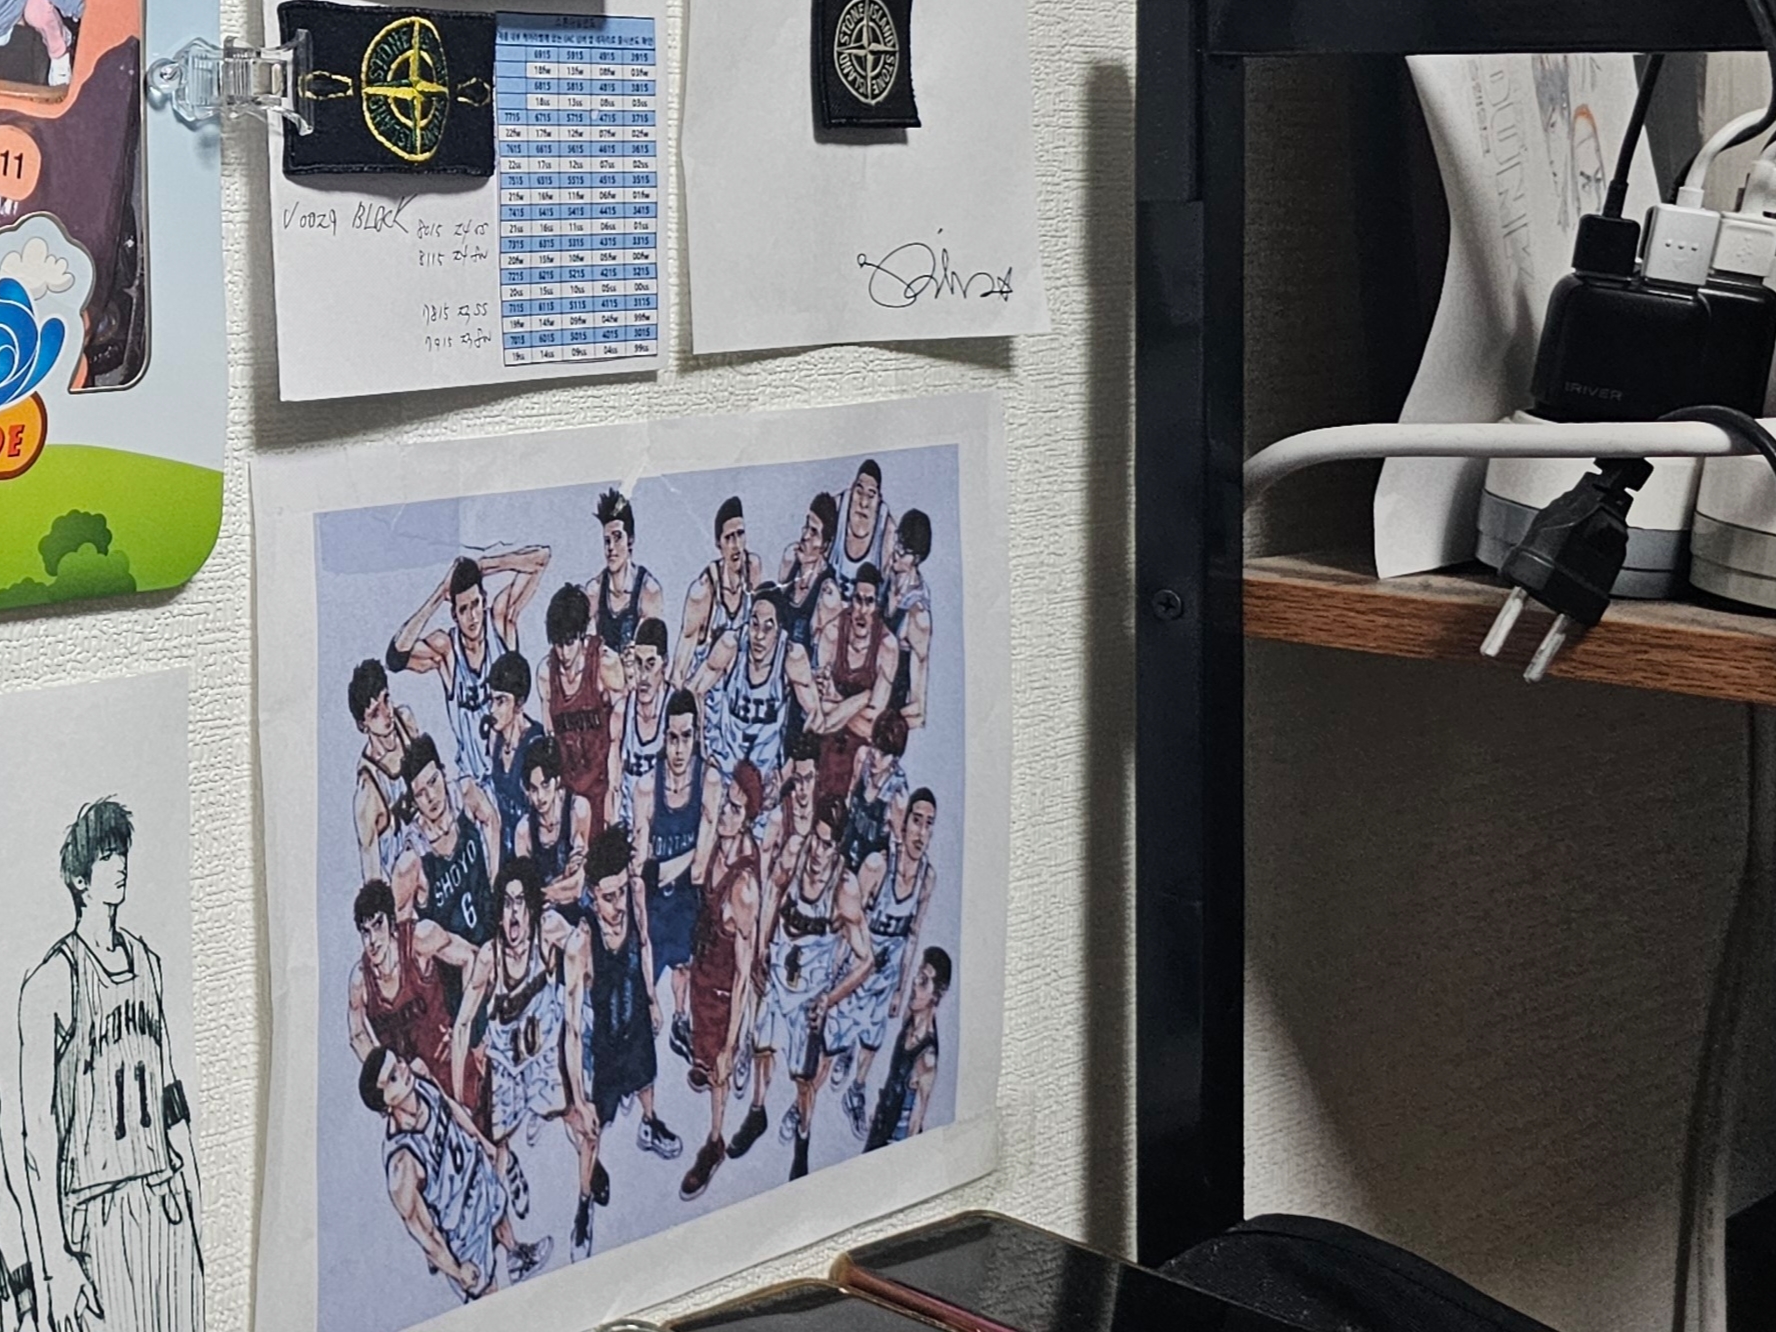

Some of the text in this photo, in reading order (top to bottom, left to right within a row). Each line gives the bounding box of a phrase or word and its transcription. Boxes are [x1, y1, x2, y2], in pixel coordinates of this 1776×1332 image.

[839, 3, 895, 47] STONE ISLAND
[0, 149, 26, 180] 11
[434, 839, 477, 907] SHOYO
[461, 891, 478, 929] 6
[114, 1059, 152, 1141] 11
